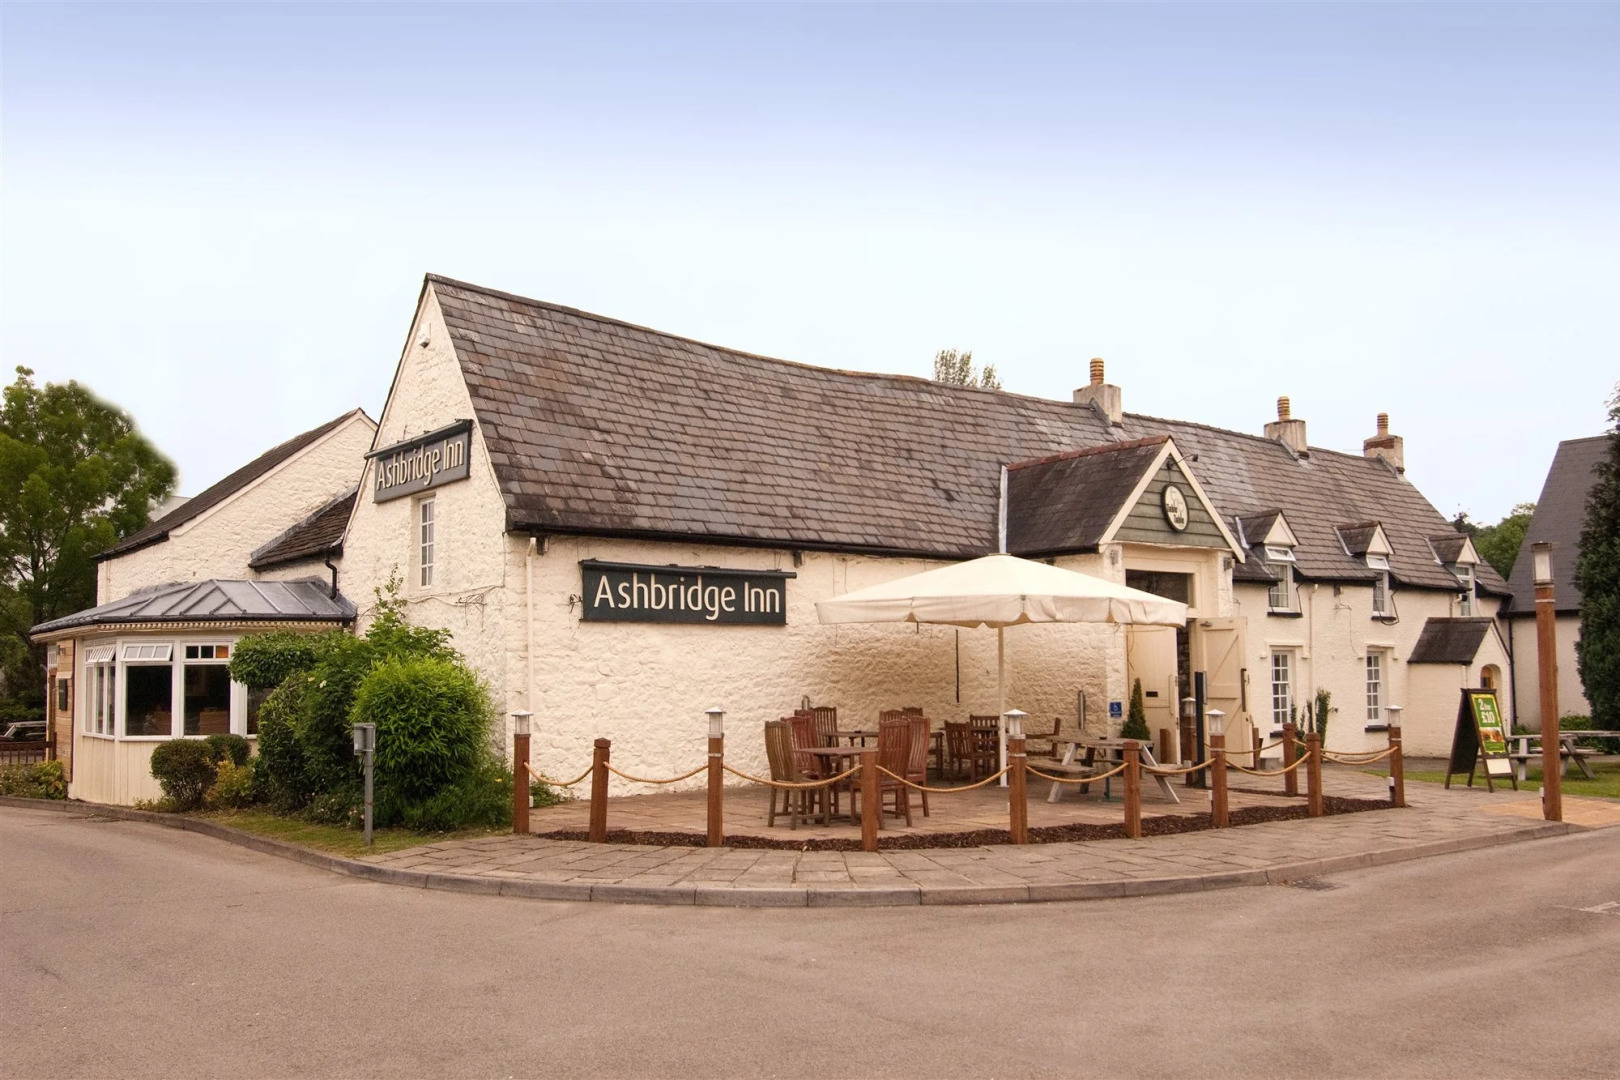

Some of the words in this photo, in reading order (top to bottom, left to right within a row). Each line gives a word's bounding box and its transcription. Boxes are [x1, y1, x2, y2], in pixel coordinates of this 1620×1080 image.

[376, 443, 441, 491] Ashbridge
[443, 440, 464, 471] Inn
[593, 572, 736, 621] Ashbridge
[744, 581, 780, 613] Inn
[1478, 698, 1484, 710] 2
[1481, 711, 1495, 723] £10
